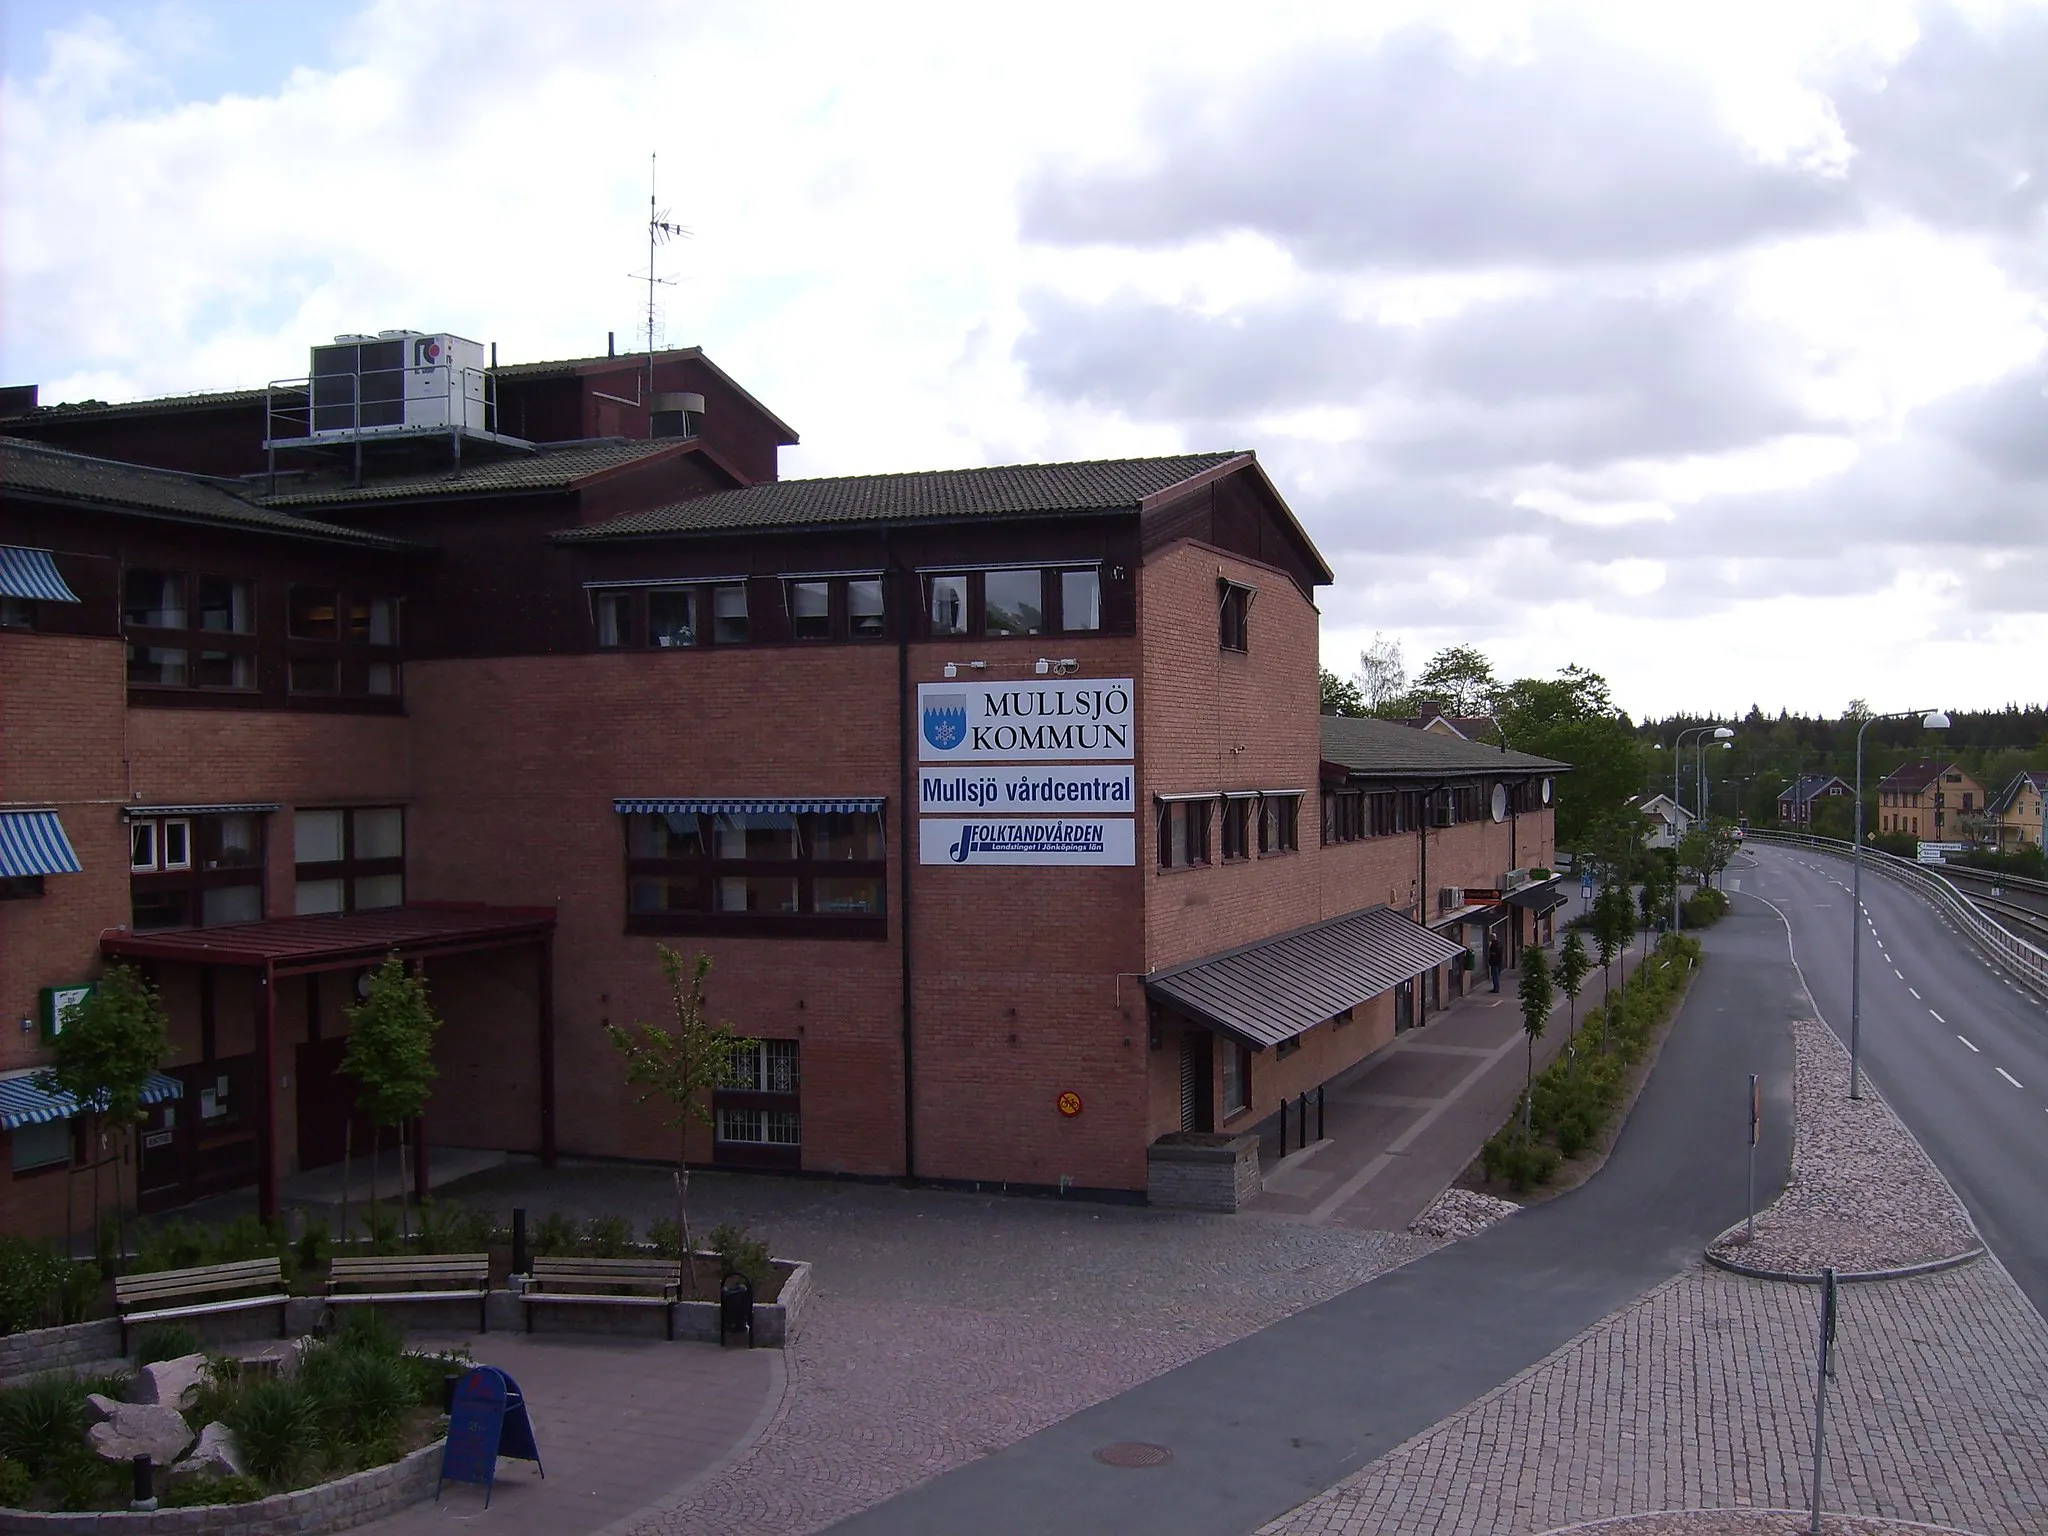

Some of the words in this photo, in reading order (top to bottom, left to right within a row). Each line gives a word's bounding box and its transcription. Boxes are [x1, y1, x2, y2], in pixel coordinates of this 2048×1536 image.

[984, 684, 1128, 721] MULLSJÖ
[972, 724, 1128, 750] KOMMUN
[923, 777, 998, 807] Mullsjö
[1006, 776, 1130, 801] vårdcentral
[972, 820, 1103, 842] FOLKTANDVÅRDEN
[992, 843, 1036, 851] Landstinget
[1042, 843, 1087, 852] Jönköpings
